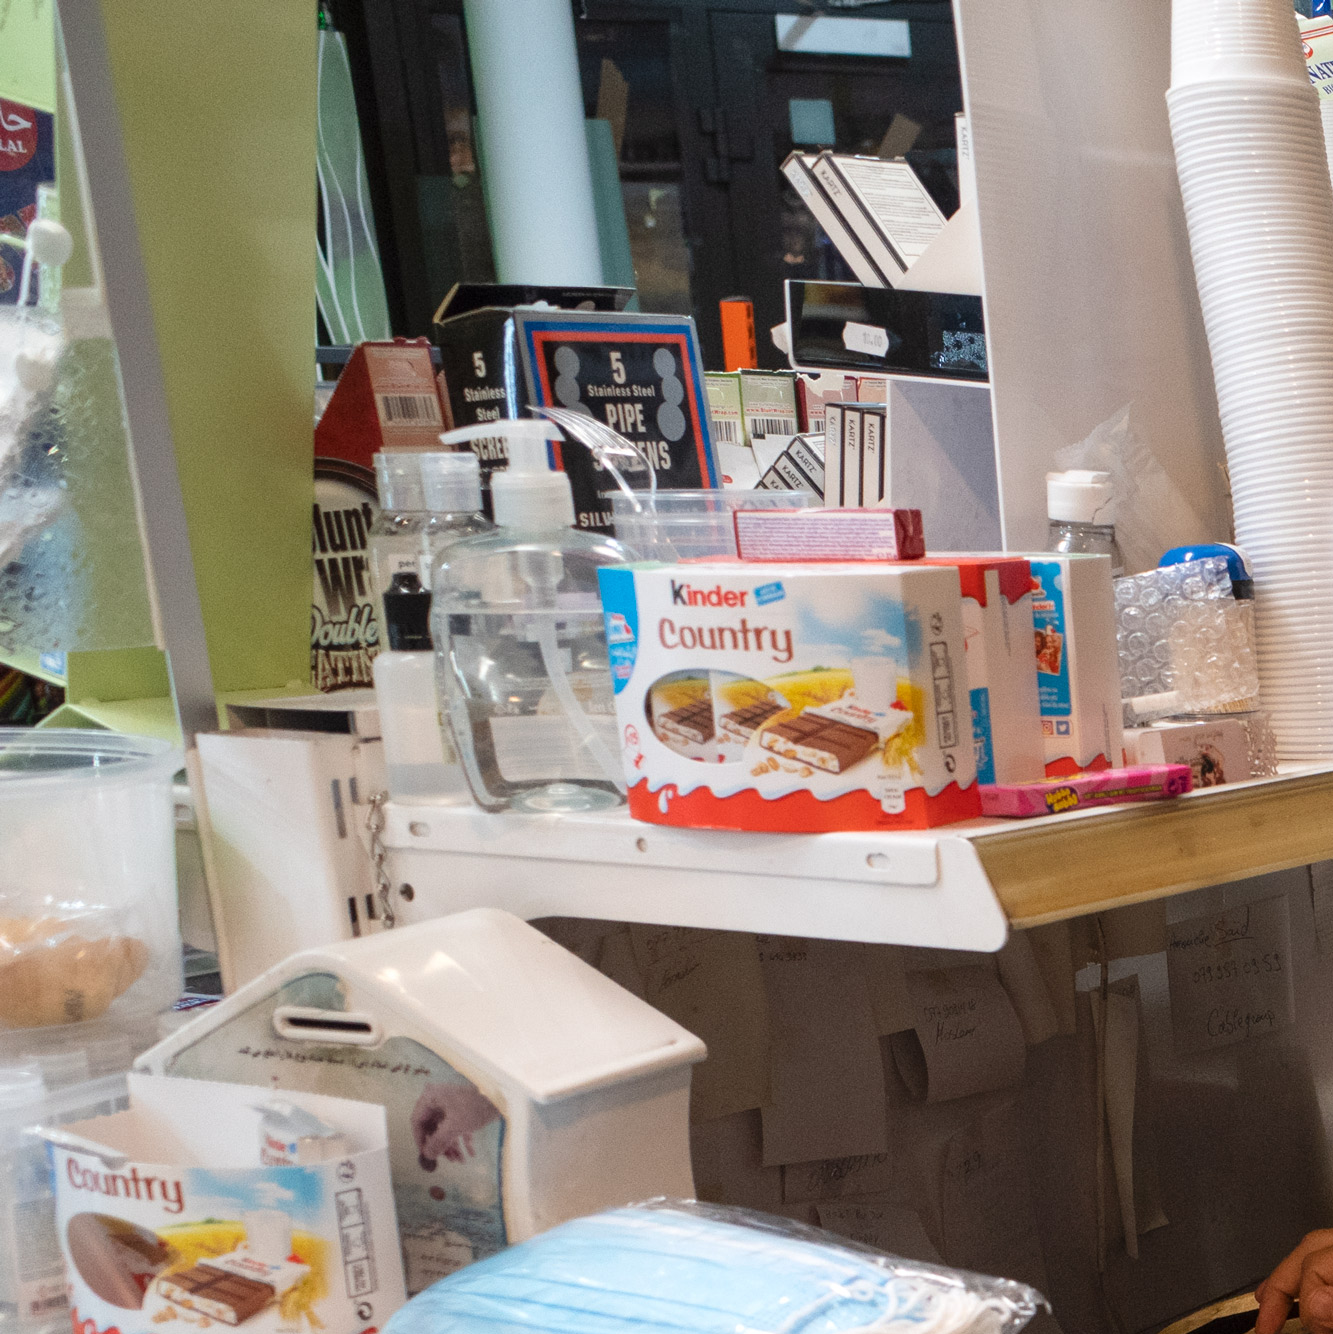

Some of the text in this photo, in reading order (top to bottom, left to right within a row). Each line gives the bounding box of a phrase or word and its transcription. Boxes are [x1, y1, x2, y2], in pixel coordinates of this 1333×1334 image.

[472, 352, 487, 378] 5
[609, 351, 626, 384] 5
[464, 387, 506, 402] Stainless
[587, 384, 656, 397] Stainless Steel
[476, 407, 500, 422] Steel
[606, 404, 647, 433] PIPE
[868, 423, 876, 454] KARTZ
[796, 450, 817, 474] KARTZ
[782, 464, 804, 489] KARTZ
[658, 618, 794, 663] Country
[66, 1157, 185, 1214] Country
